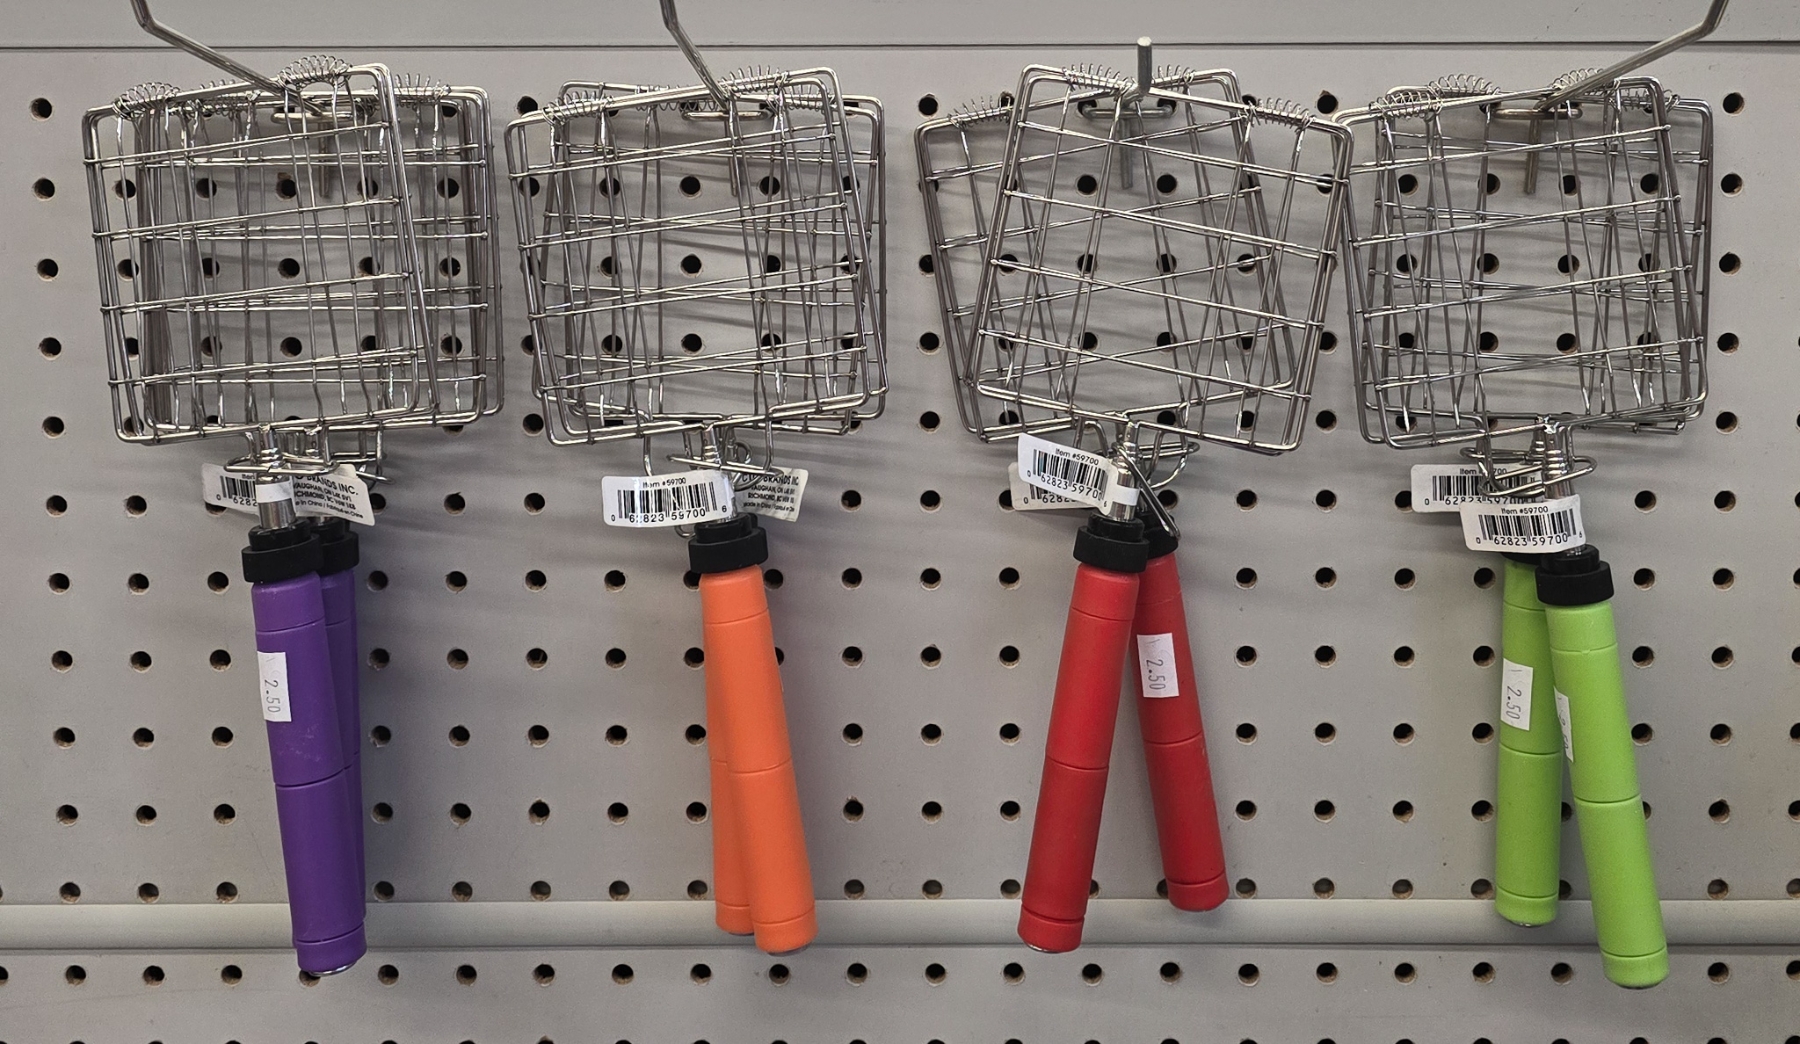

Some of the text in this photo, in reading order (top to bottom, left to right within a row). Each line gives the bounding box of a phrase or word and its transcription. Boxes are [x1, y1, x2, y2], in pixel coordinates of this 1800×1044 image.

[1056, 448, 1100, 466] Item #59700
[339, 483, 359, 495] INC.
[662, 477, 687, 487] #59700
[1041, 474, 1068, 490] 62823
[233, 496, 258, 507] 6282
[1042, 495, 1076, 503] 628
[611, 504, 727, 523] 0 6823 59700 6
[1520, 506, 1549, 514] #59700
[1494, 535, 1528, 546] 62823
[1531, 533, 1568, 546] 59700
[1146, 659, 1166, 690] 2.50
[264, 679, 281, 713] 2.50
[1506, 685, 1522, 720] 2.50
